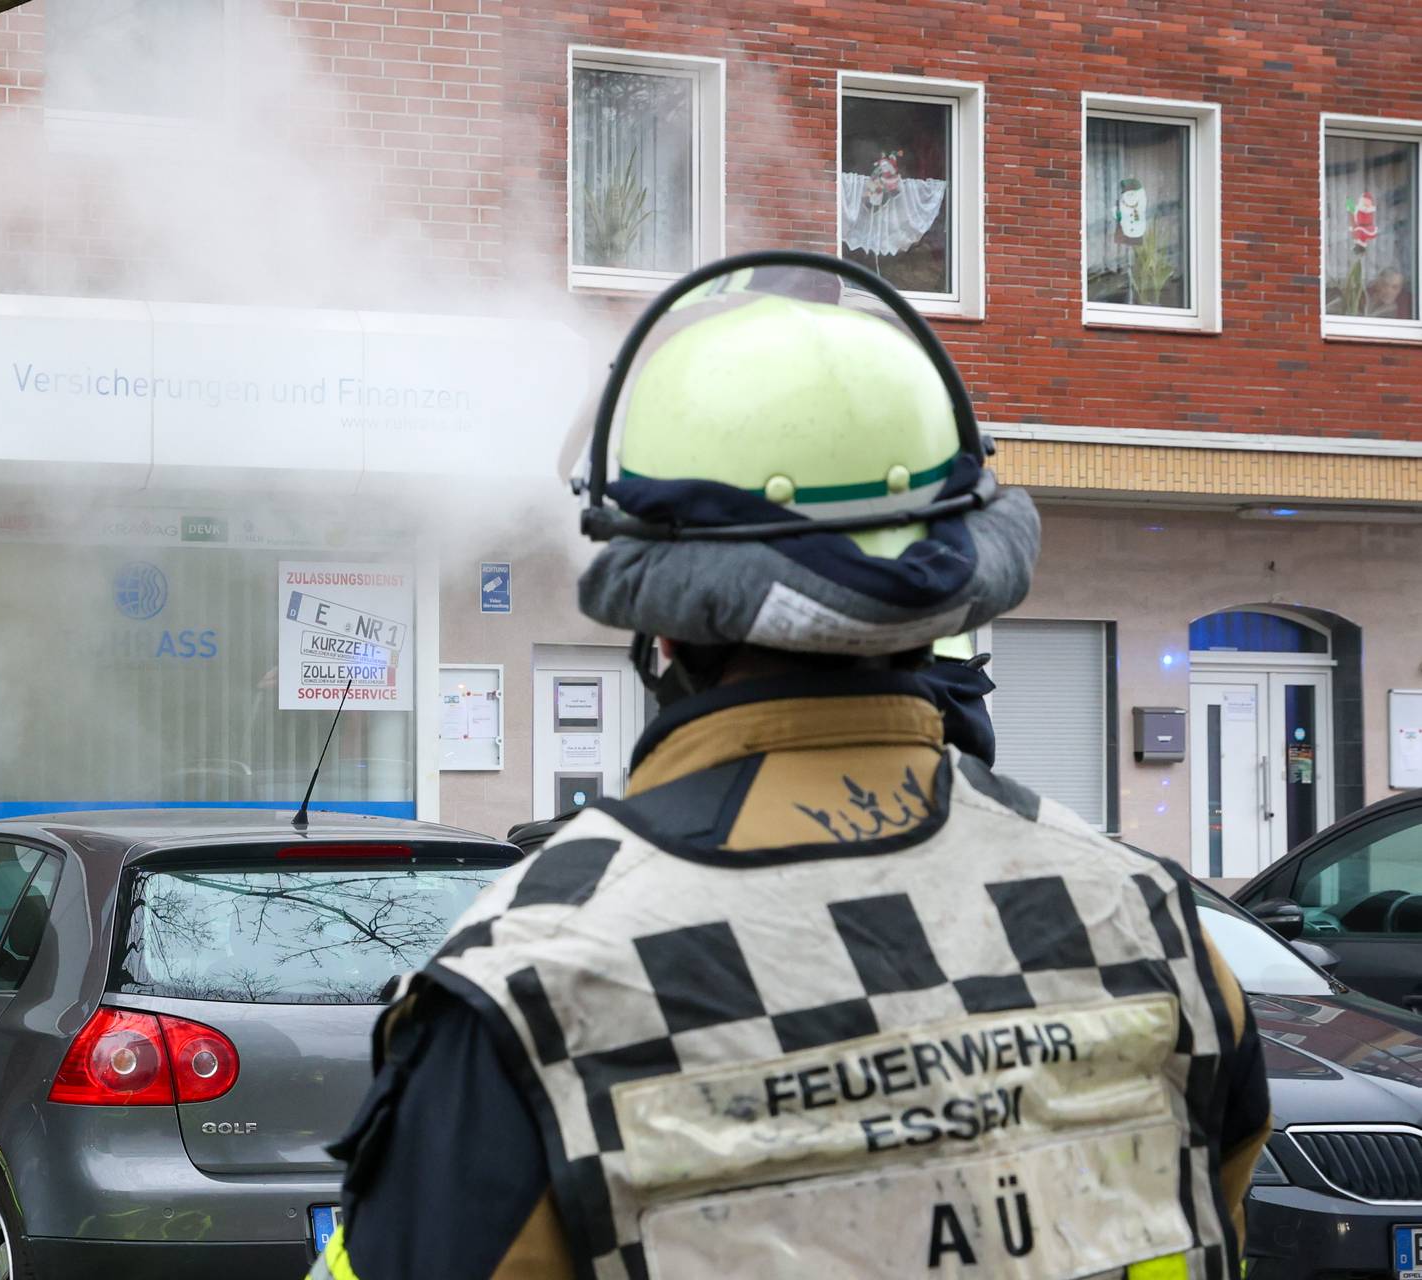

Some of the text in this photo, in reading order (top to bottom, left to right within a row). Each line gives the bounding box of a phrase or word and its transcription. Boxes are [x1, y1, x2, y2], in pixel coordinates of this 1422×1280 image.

[12, 362, 259, 408] Versicherungen
[271, 377, 325, 404] und
[189, 524, 221, 536] DEVK
[286, 571, 404, 587] ZULASSUNGSDIENST
[315, 603, 330, 626] E
[355, 615, 383, 642] NR
[385, 625, 398, 647] 1
[338, 665, 386, 680] EXPORT
[764, 1022, 1077, 1117] FEUERWEHR
[201, 1121, 258, 1135] GOLF
[859, 1085, 1023, 1153] ESSEN
[928, 1175, 1034, 1269] A Ü
